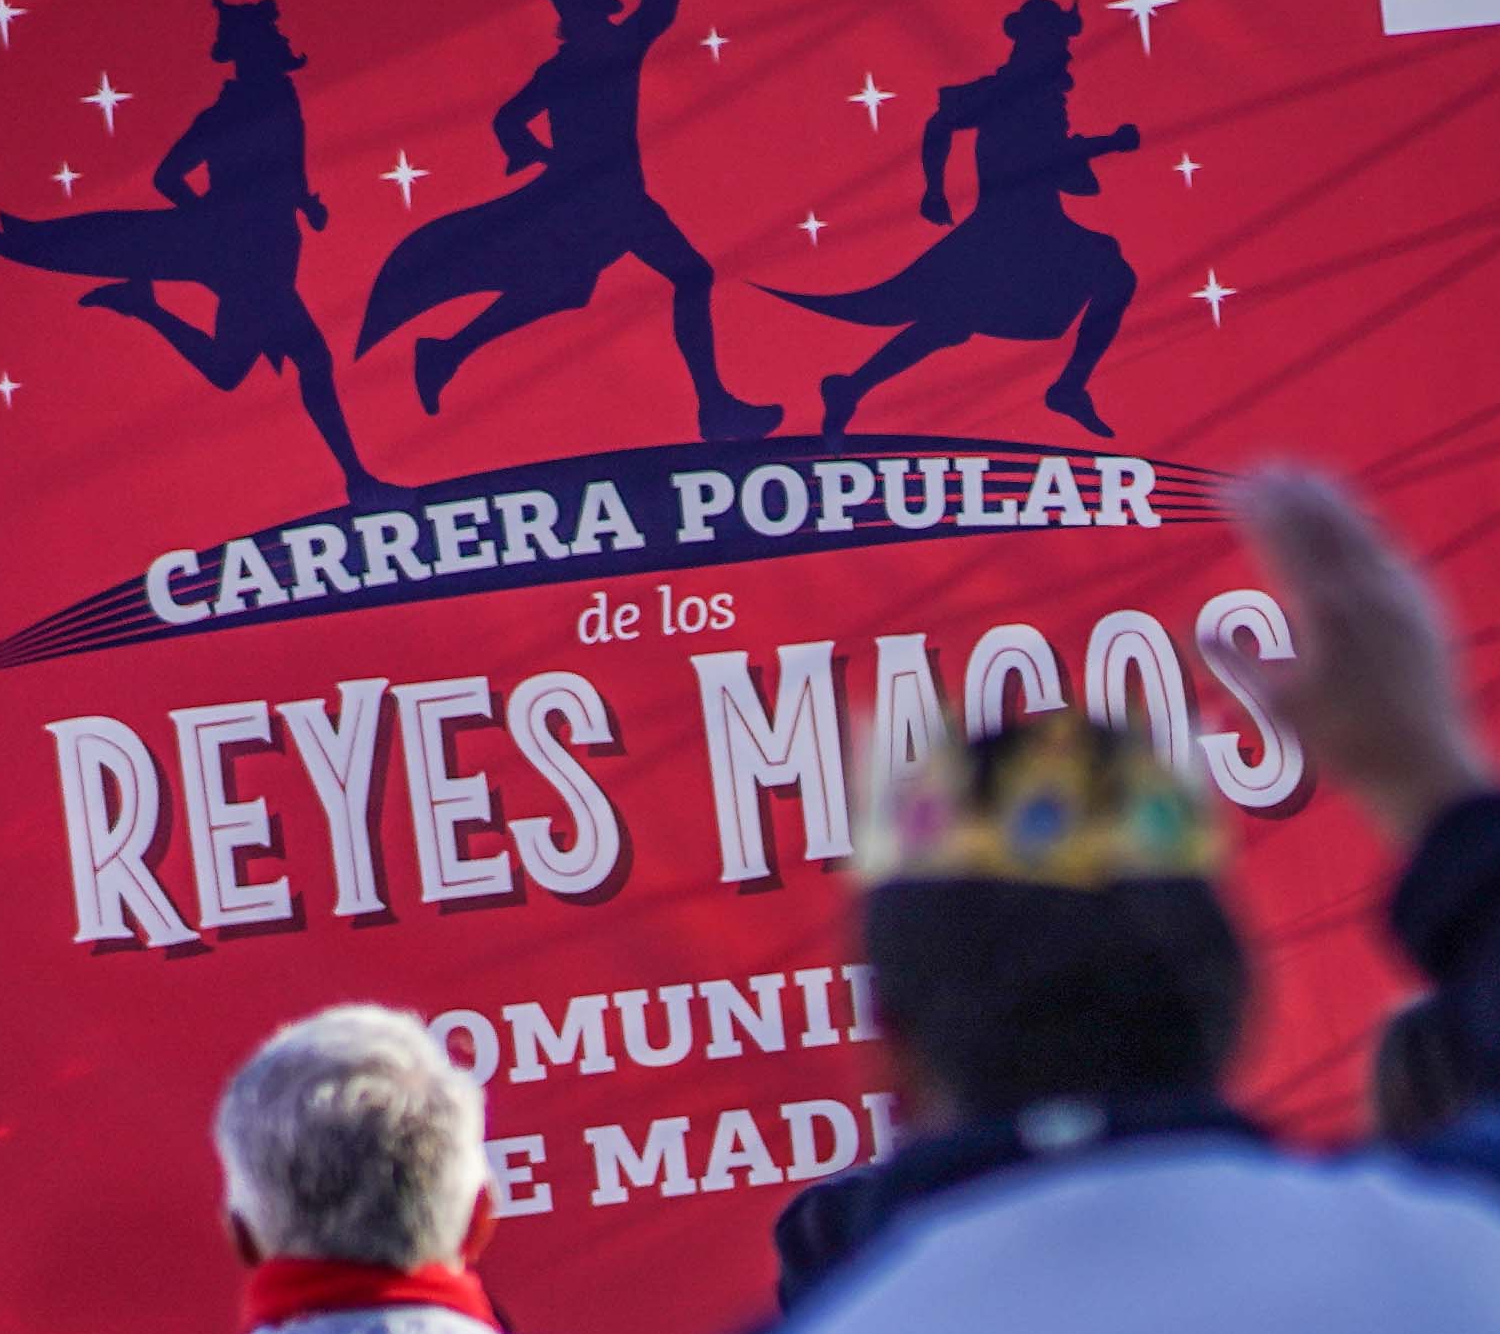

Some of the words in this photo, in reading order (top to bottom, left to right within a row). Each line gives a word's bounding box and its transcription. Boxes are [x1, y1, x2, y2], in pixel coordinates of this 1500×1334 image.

[145, 479, 643, 625] CARRERA
[671, 455, 1161, 544] POPULAR
[577, 592, 642, 645] de
[657, 584, 737, 636] los
[44, 670, 621, 949] REYES
[426, 964, 884, 1088] OMUNI
[483, 1134, 553, 1220] E
[584, 1091, 900, 1207] MAD
